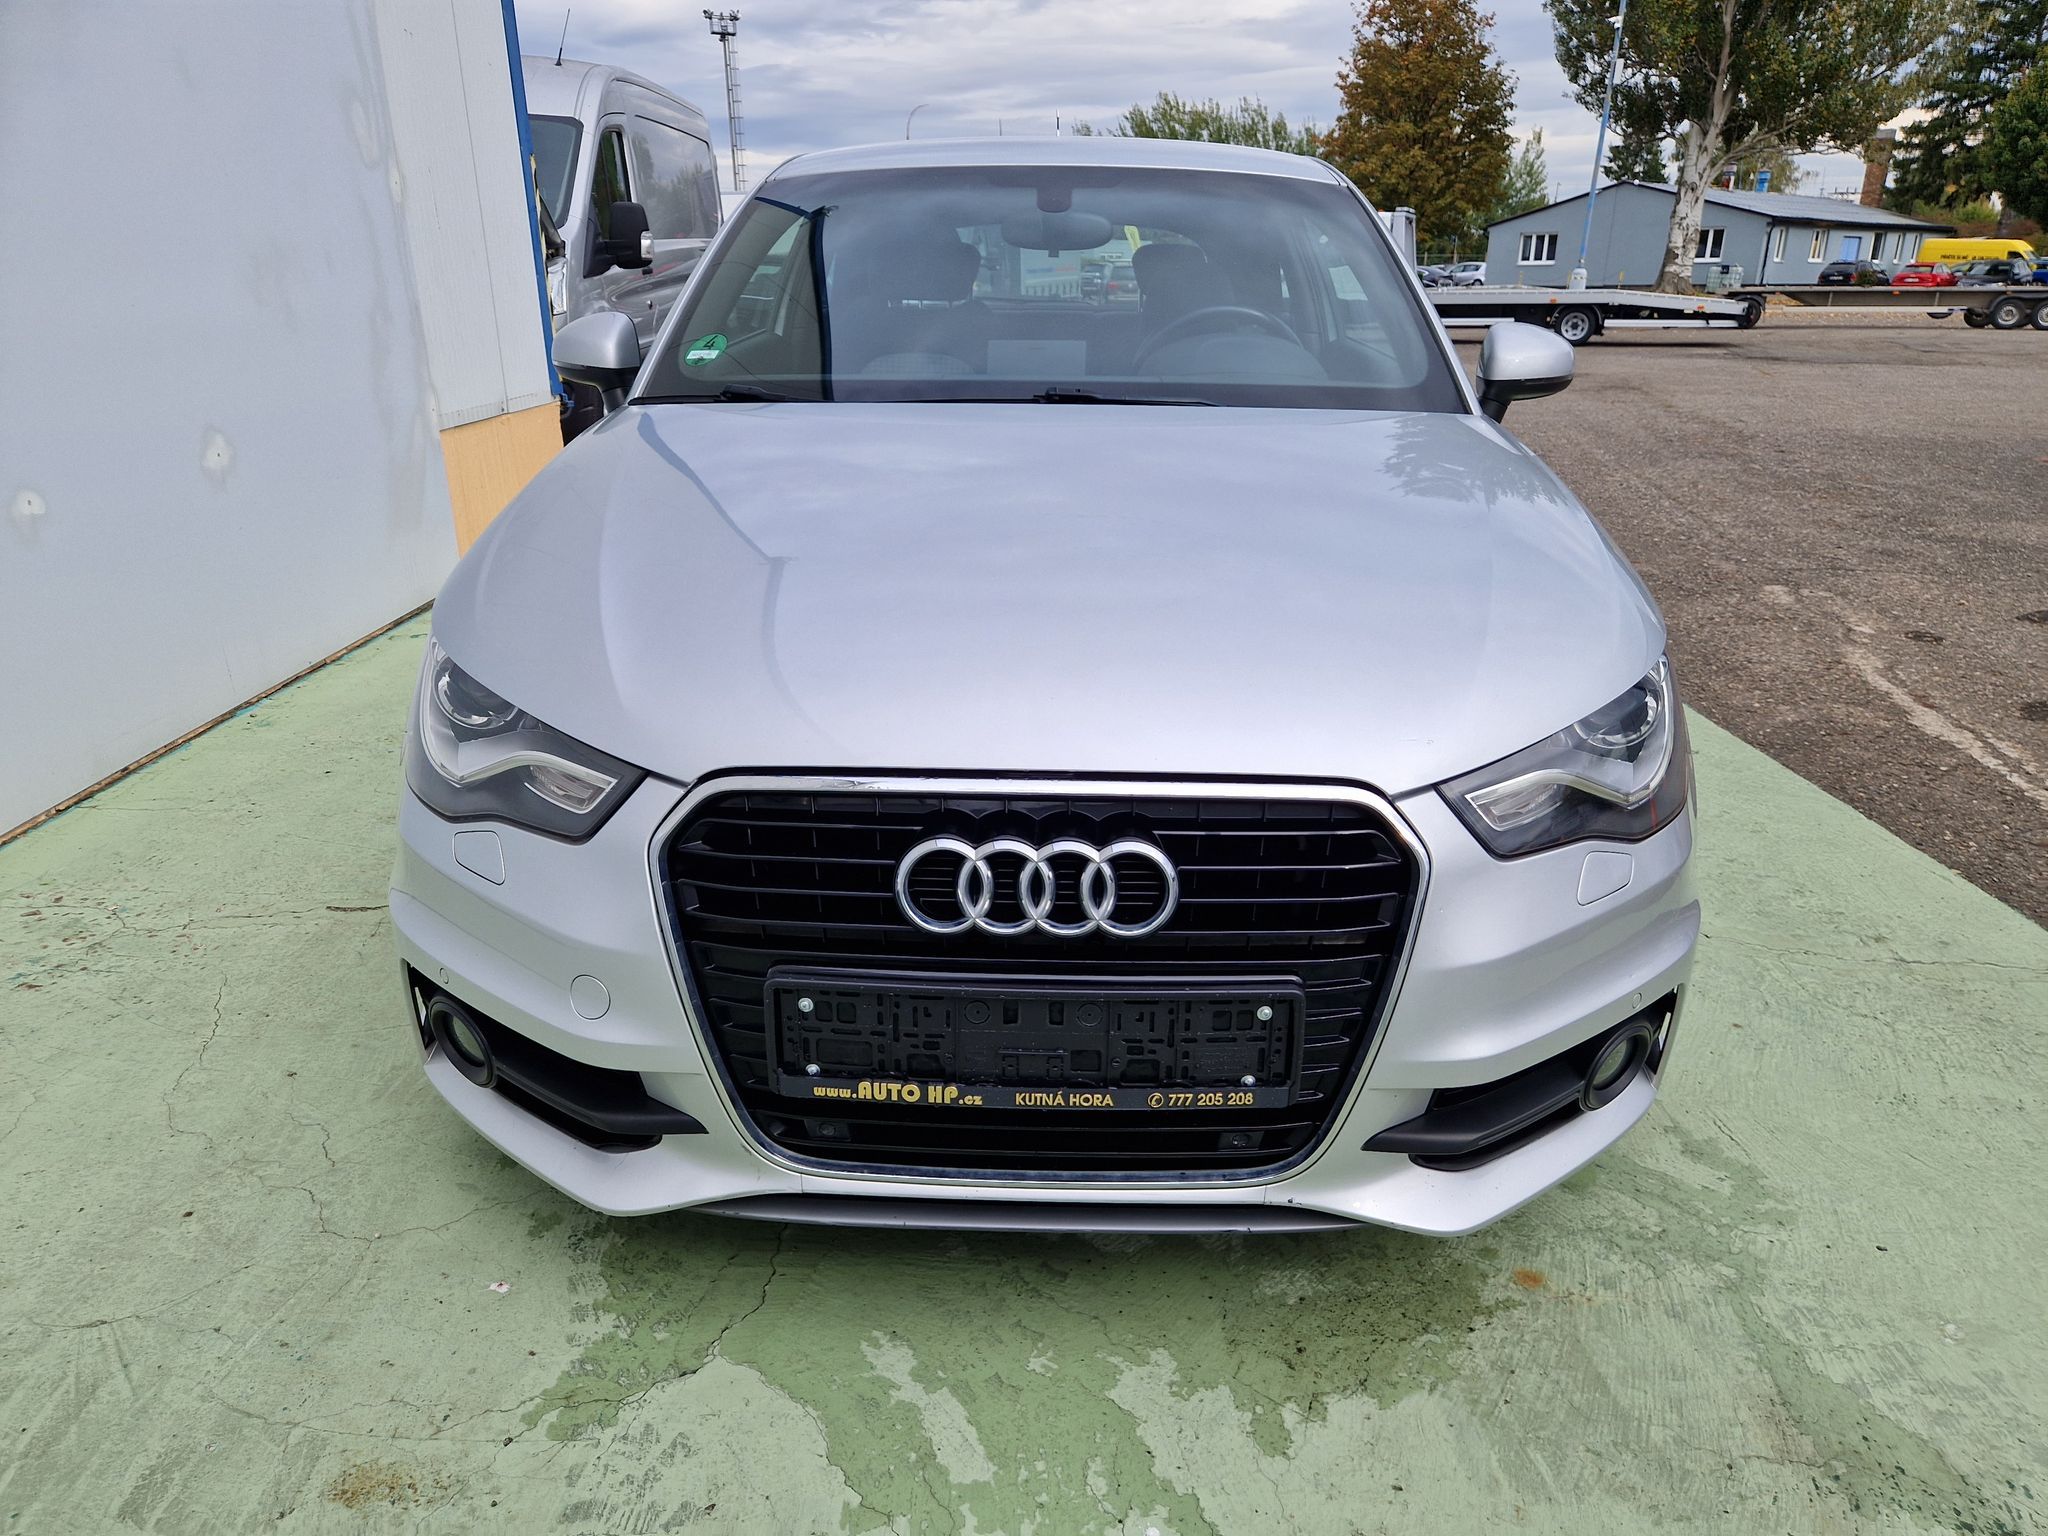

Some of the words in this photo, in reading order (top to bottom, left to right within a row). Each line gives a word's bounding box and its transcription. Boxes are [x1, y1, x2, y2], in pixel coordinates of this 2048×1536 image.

[703, 334, 718, 350] 4
[813, 1081, 921, 1103] www.AUTO
[927, 1085, 983, 1105] HP.cz
[1015, 1090, 1065, 1107] KUTNÁ
[1069, 1093, 1114, 1107] HORA
[1168, 1093, 1193, 1107] 777
[1197, 1092, 1223, 1106] 205
[1227, 1092, 1253, 1105] 208
